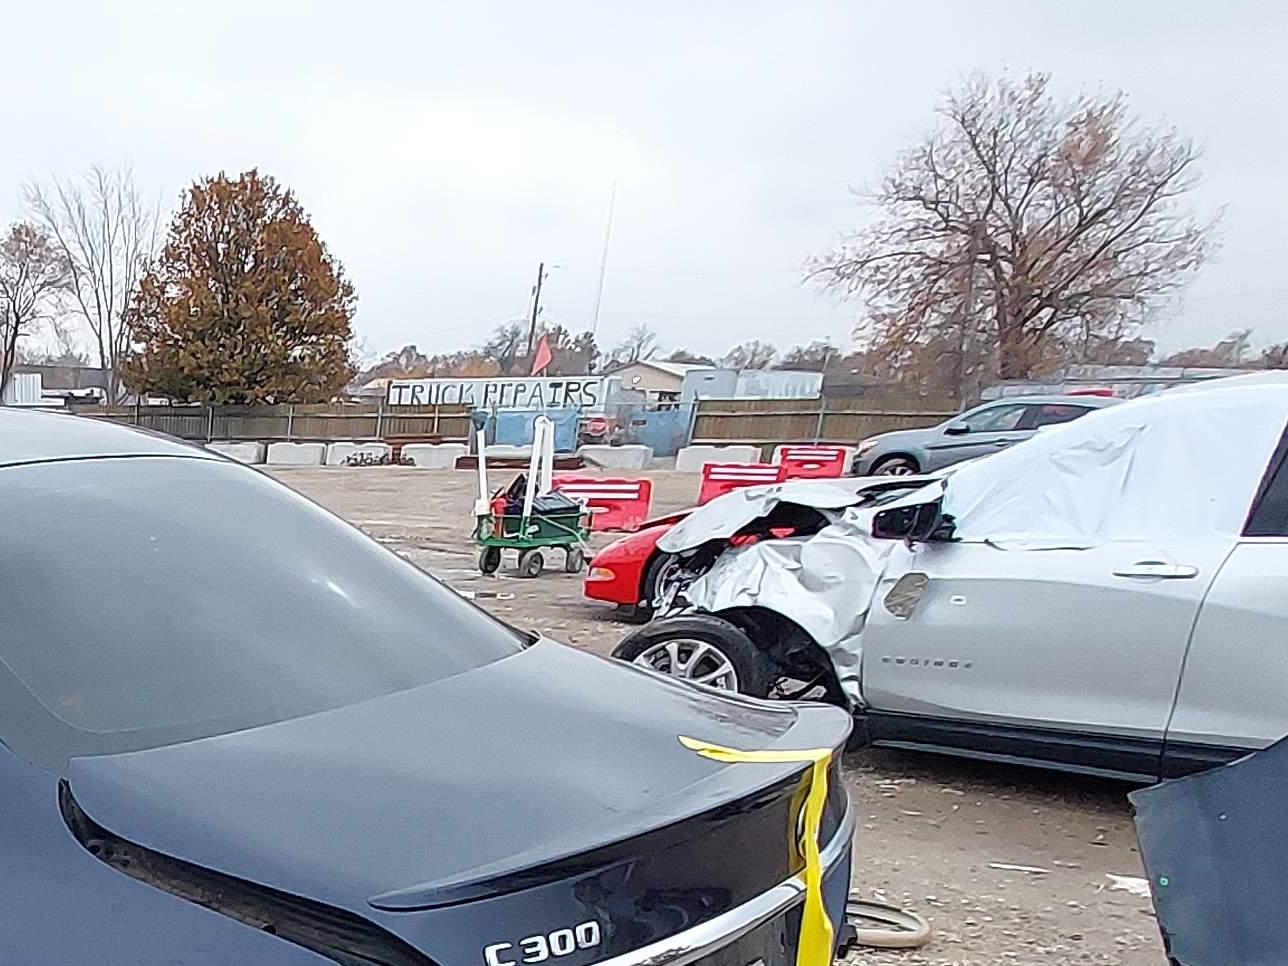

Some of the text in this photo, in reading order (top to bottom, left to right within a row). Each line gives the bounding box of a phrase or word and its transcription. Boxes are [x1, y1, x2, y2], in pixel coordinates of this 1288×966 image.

[391, 381, 599, 408] TRUCK REPAIRS
[519, 920, 601, 964] 300
